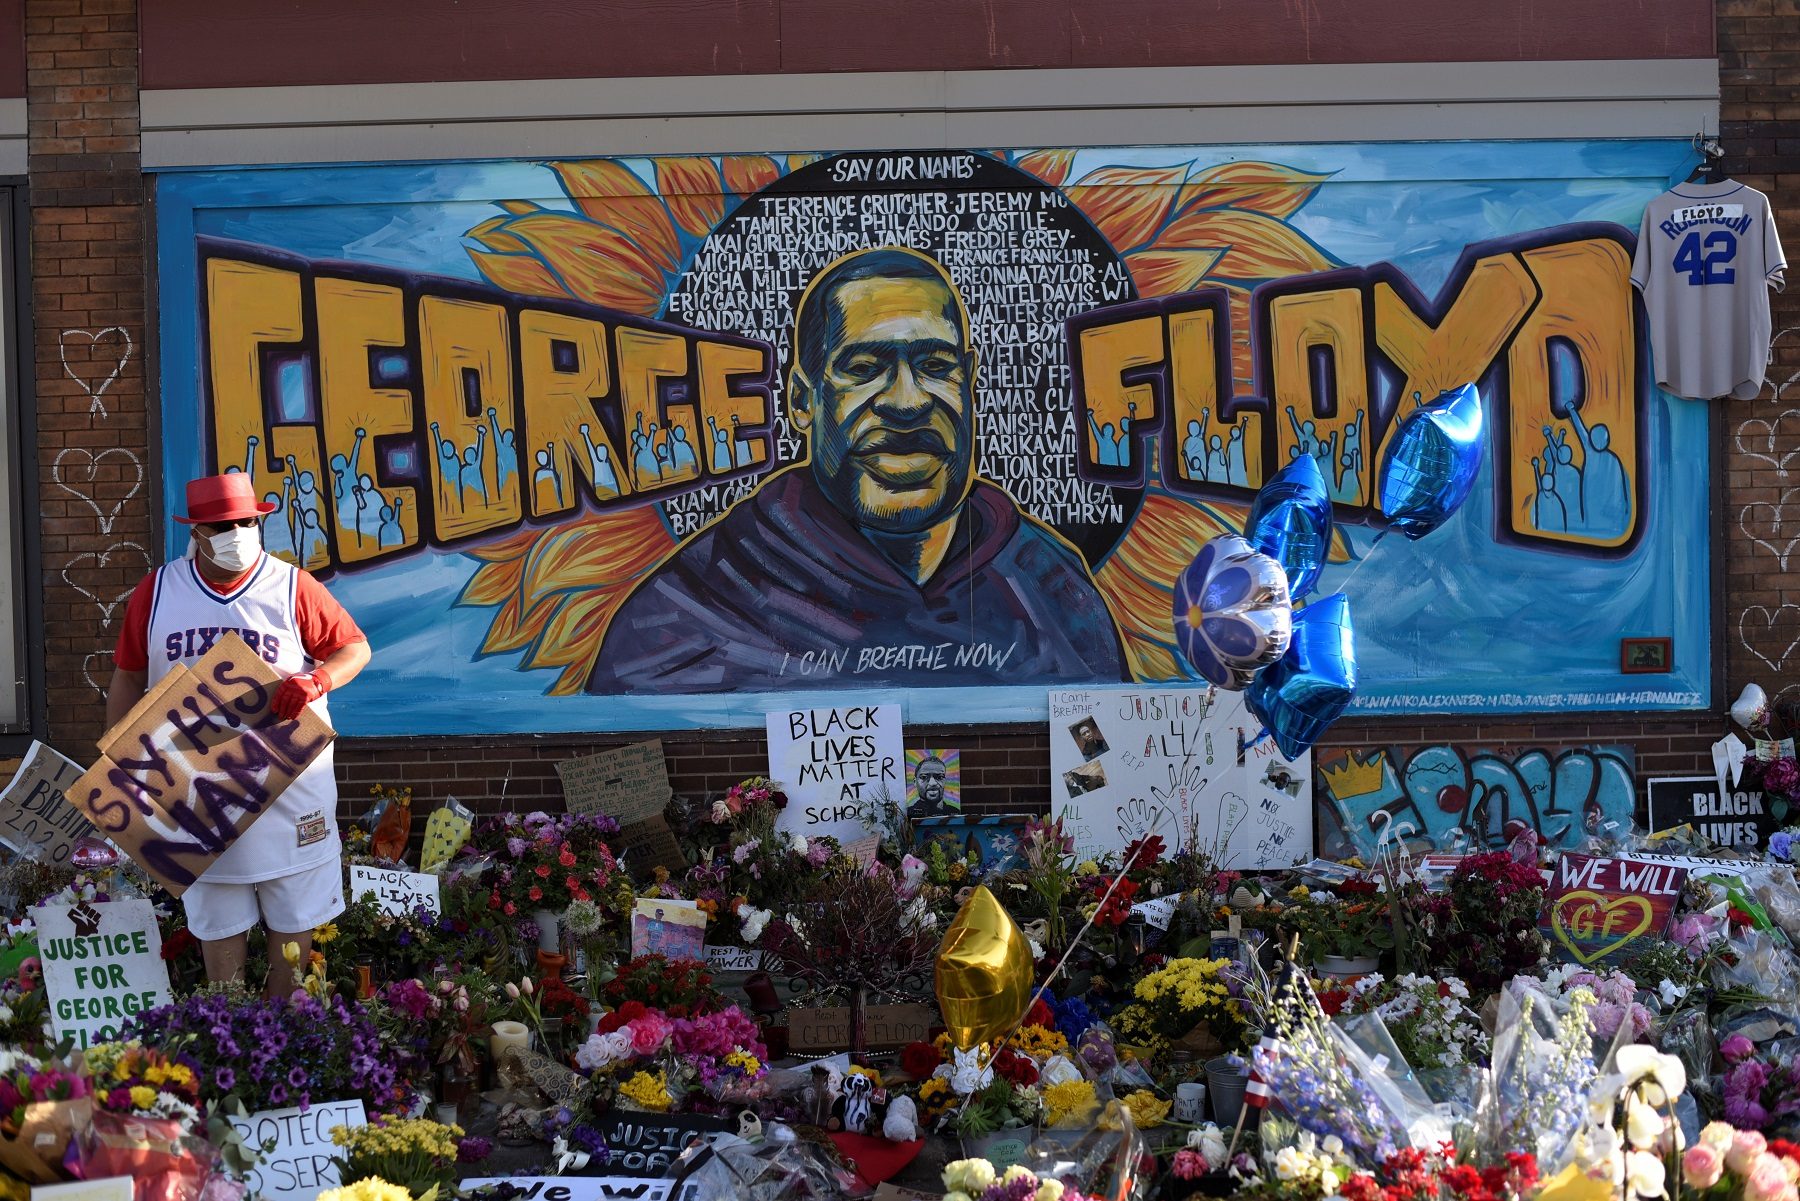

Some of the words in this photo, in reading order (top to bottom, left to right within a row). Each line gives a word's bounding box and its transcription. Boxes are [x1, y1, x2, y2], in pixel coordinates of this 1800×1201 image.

[833, 158, 873, 182] SAY
[876, 157, 916, 181] OUR
[919, 155, 975, 179] NAMES
[759, 195, 856, 217] TERRENCE
[861, 192, 949, 215] CRUTCHER
[955, 192, 1032, 214] JEREMY
[1682, 206, 1724, 220] FLOYD
[736, 216, 793, 235] TAMIR
[796, 216, 843, 234] RICE
[861, 213, 959, 231] PHILANDO
[977, 212, 1048, 231] CASTILE
[703, 234, 741, 254] AKAI
[745, 233, 801, 253] GURLEY
[804, 232, 870, 252] KENDRA
[872, 229, 931, 249] JAMES
[945, 231, 1018, 249] FREDDIE
[1022, 229, 1070, 249] GREY
[694, 252, 774, 272] MICHAEL
[934, 248, 1009, 266] TERRANCE
[1011, 248, 1090, 264] FRANKLIN
[1673, 230, 1737, 285] 42
[681, 272, 744, 294] TYISHA
[951, 265, 1031, 285] BREONNA
[1030, 264, 1097, 284] TAYLOR
[1103, 261, 1127, 282] AL
[669, 292, 710, 312] ERIC
[713, 290, 792, 310] GARNER
[960, 284, 1041, 304] SHANTEL
[1042, 282, 1094, 302] DAVIS
[683, 309, 760, 330] SANDRA
[965, 303, 1039, 325] WALTER
[969, 323, 1021, 344] REKIA
[973, 342, 1028, 366] YVETT
[976, 365, 1042, 388] SHELLY
[975, 387, 1040, 415] JAMAR
[1078, 234, 1639, 550] FLOYD
[202, 252, 770, 574] GEORGE
[976, 412, 1057, 435] TANISHA
[976, 434, 1046, 456] TARIKA
[978, 455, 1038, 479] ALTON
[1029, 503, 1123, 525] KATHRYN
[780, 651, 789, 676] I
[800, 647, 849, 676] CAN
[853, 642, 953, 674] BREATHE
[954, 641, 1018, 672] NOW
[166, 661, 269, 755] HIS
[1119, 694, 1213, 721] JUSTICE
[788, 706, 880, 740] BLACK
[810, 735, 876, 763] LIVES
[87, 733, 175, 833] SAY
[798, 756, 896, 786] MATTER
[139, 712, 329, 887] NAME
[839, 782, 867, 801] AT
[1061, 804, 1083, 820] ALL
[1692, 791, 1764, 817] BLACK
[1700, 821, 1759, 847] LIVES
[1628, 852, 1681, 862] BLACK
[1687, 855, 1737, 867] LIVES
[357, 870, 411, 890] BLACK
[1562, 854, 1612, 890] WE
[1619, 861, 1679, 896] WILL
[380, 886, 435, 908] LIVES
[1571, 903, 1630, 940] GF
[43, 930, 149, 961] JUSTICE
[710, 947, 734, 956] REST
[74, 963, 131, 990] FOR
[56, 991, 157, 1021] GEORGE
[874, 1023, 924, 1042] FLOYD
[271, 1154, 335, 1191] SER
